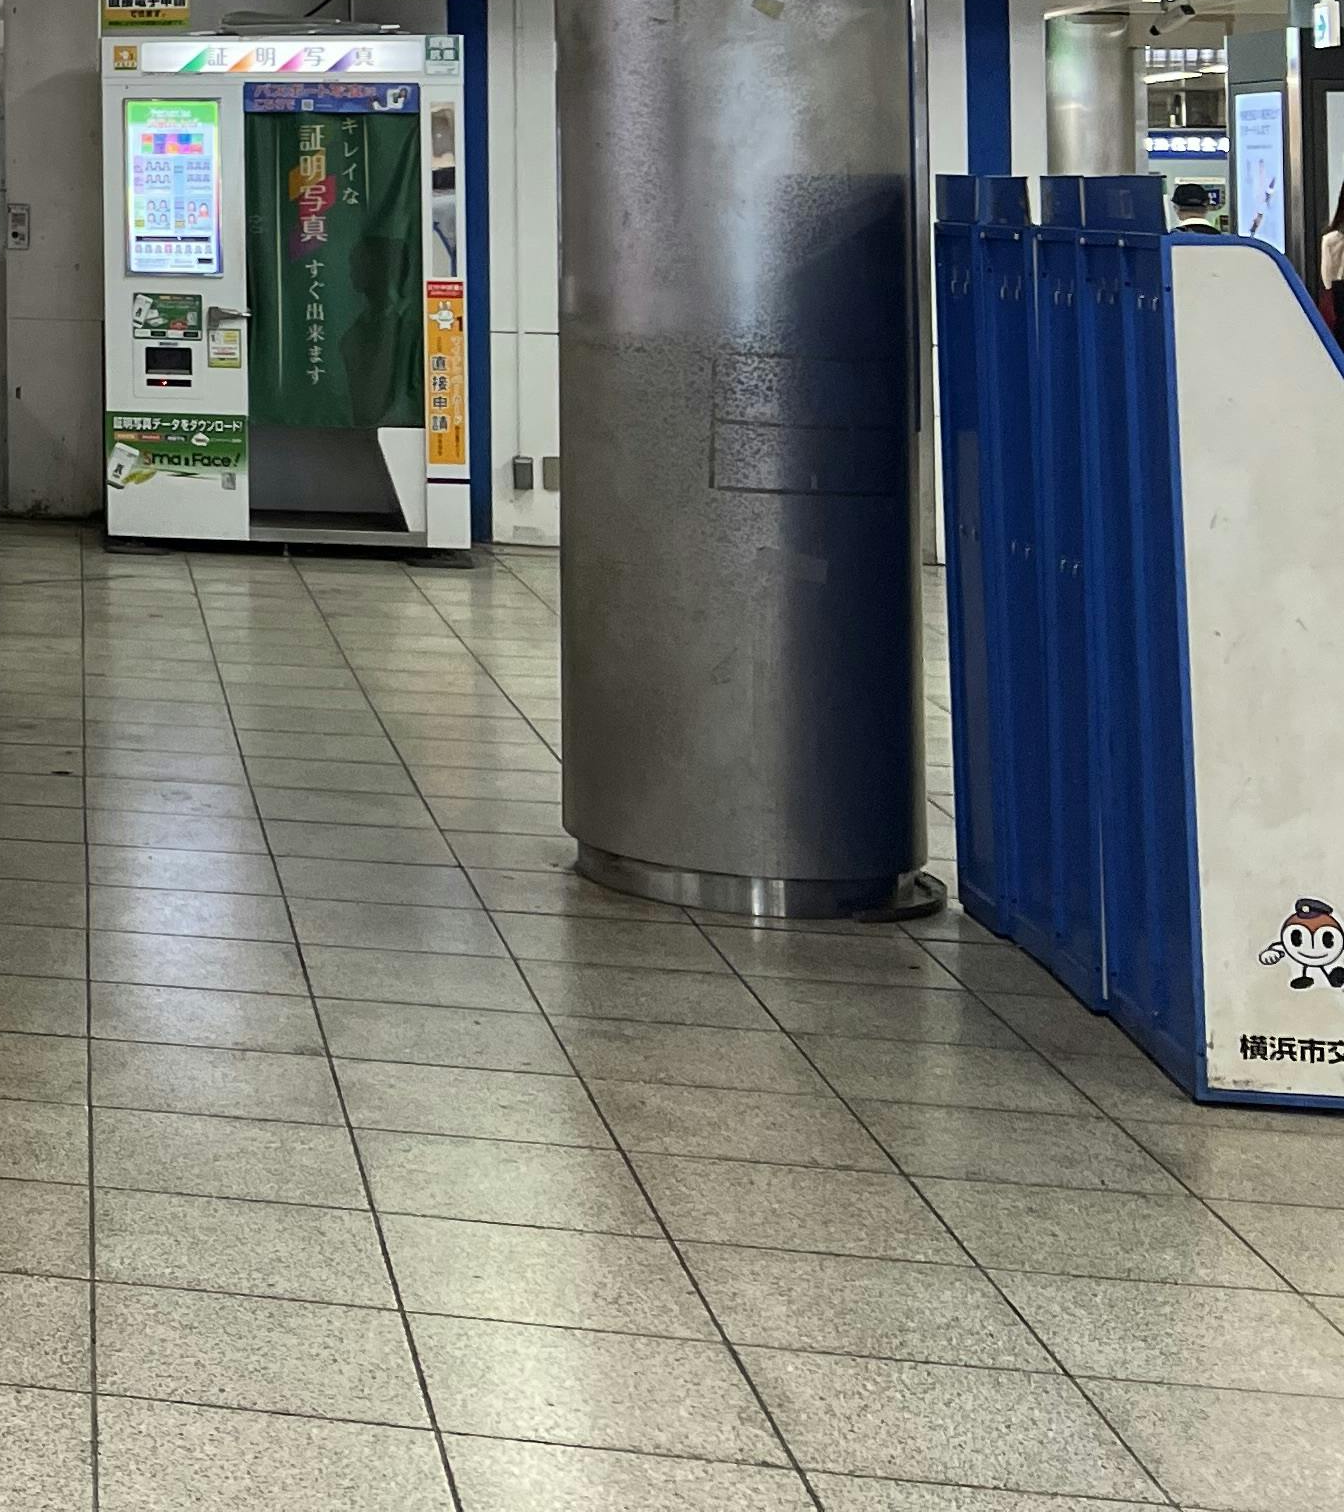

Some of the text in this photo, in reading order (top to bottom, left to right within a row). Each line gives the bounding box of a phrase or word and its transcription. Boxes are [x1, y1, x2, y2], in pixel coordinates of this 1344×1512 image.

[207, 46, 376, 68] 証明写真
[341, 117, 360, 206] キレイな
[299, 124, 328, 385] 証明写真 すぐ出来ます
[1239, 1033, 1344, 1064] 横浜市交
